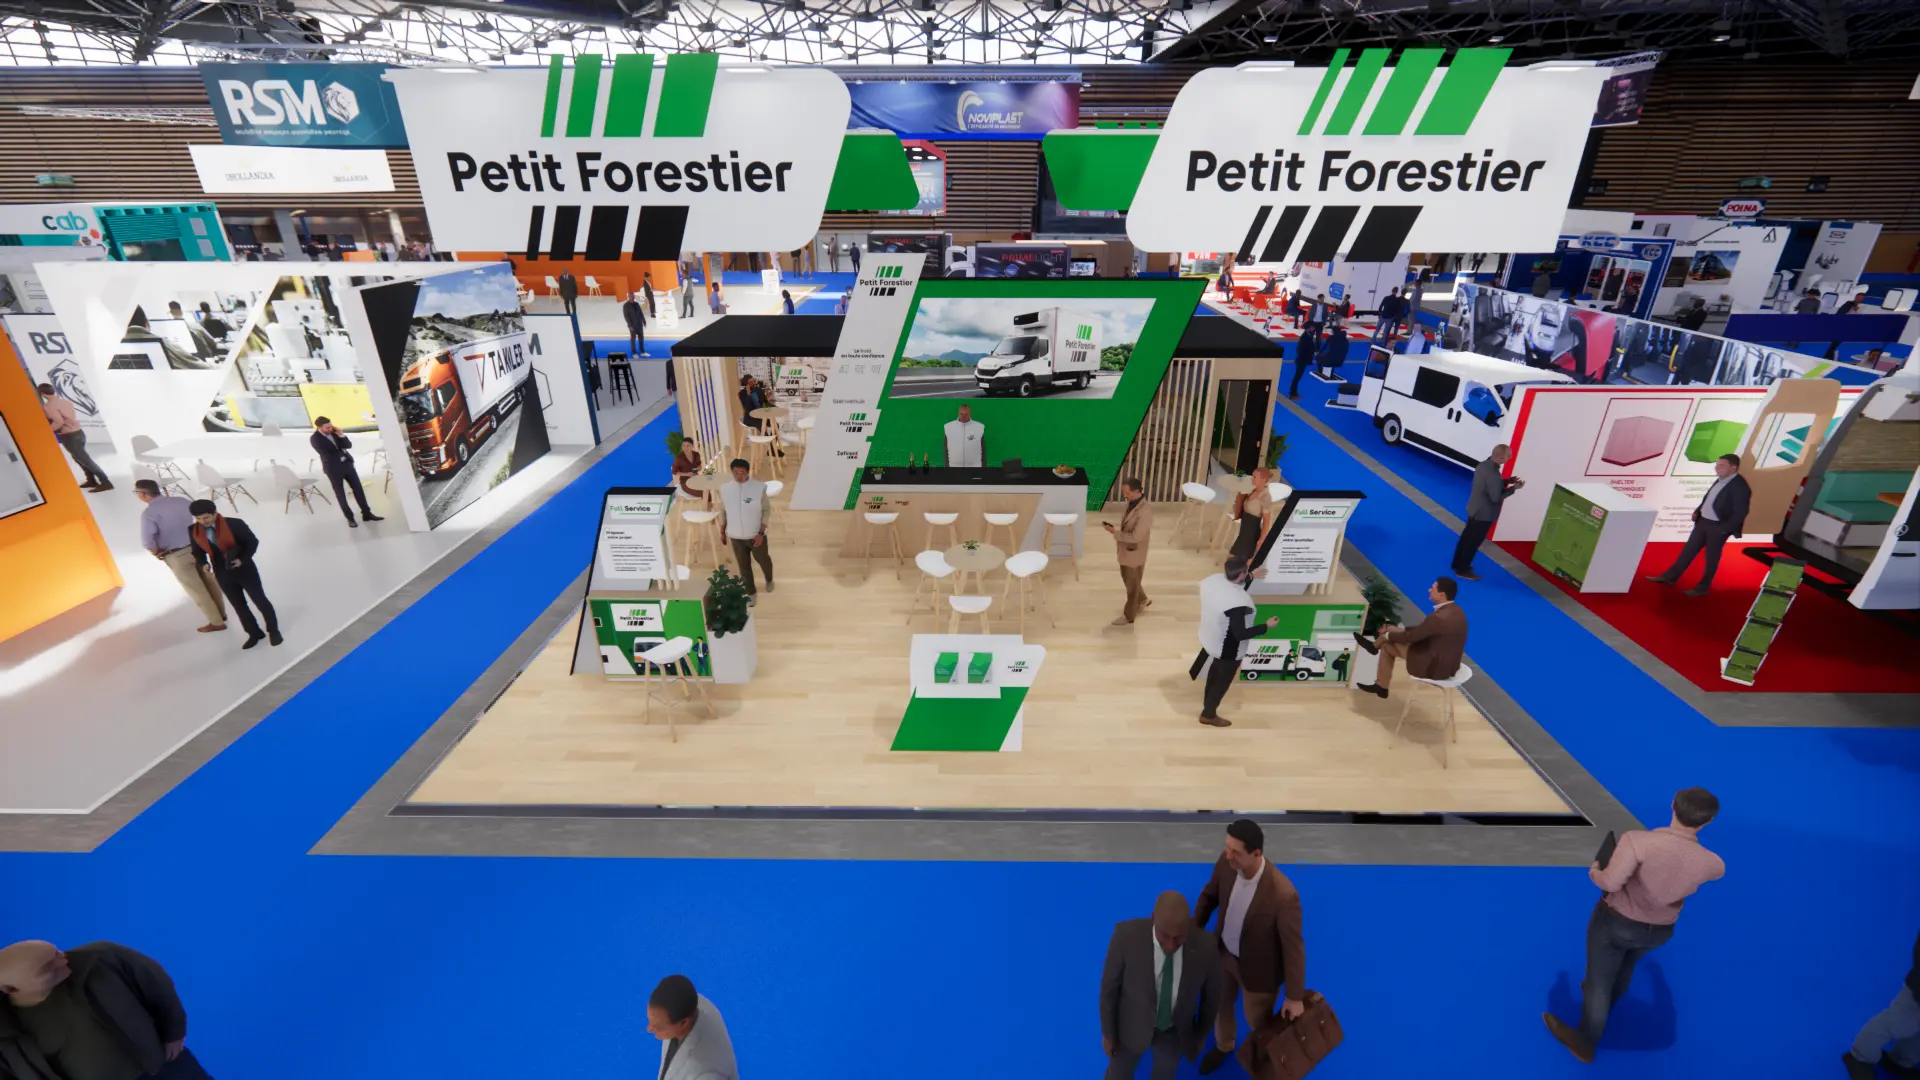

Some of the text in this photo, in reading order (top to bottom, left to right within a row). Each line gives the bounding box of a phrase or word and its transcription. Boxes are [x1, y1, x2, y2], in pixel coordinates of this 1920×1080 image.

[218, 79, 327, 125] RSM
[968, 112, 1024, 124] NOVIPLAST
[447, 150, 793, 192] Petit Forestier
[1186, 149, 1546, 192] Petit Forestier
[42, 211, 88, 231] cab
[1065, 340, 1096, 351] Petit Forestier
